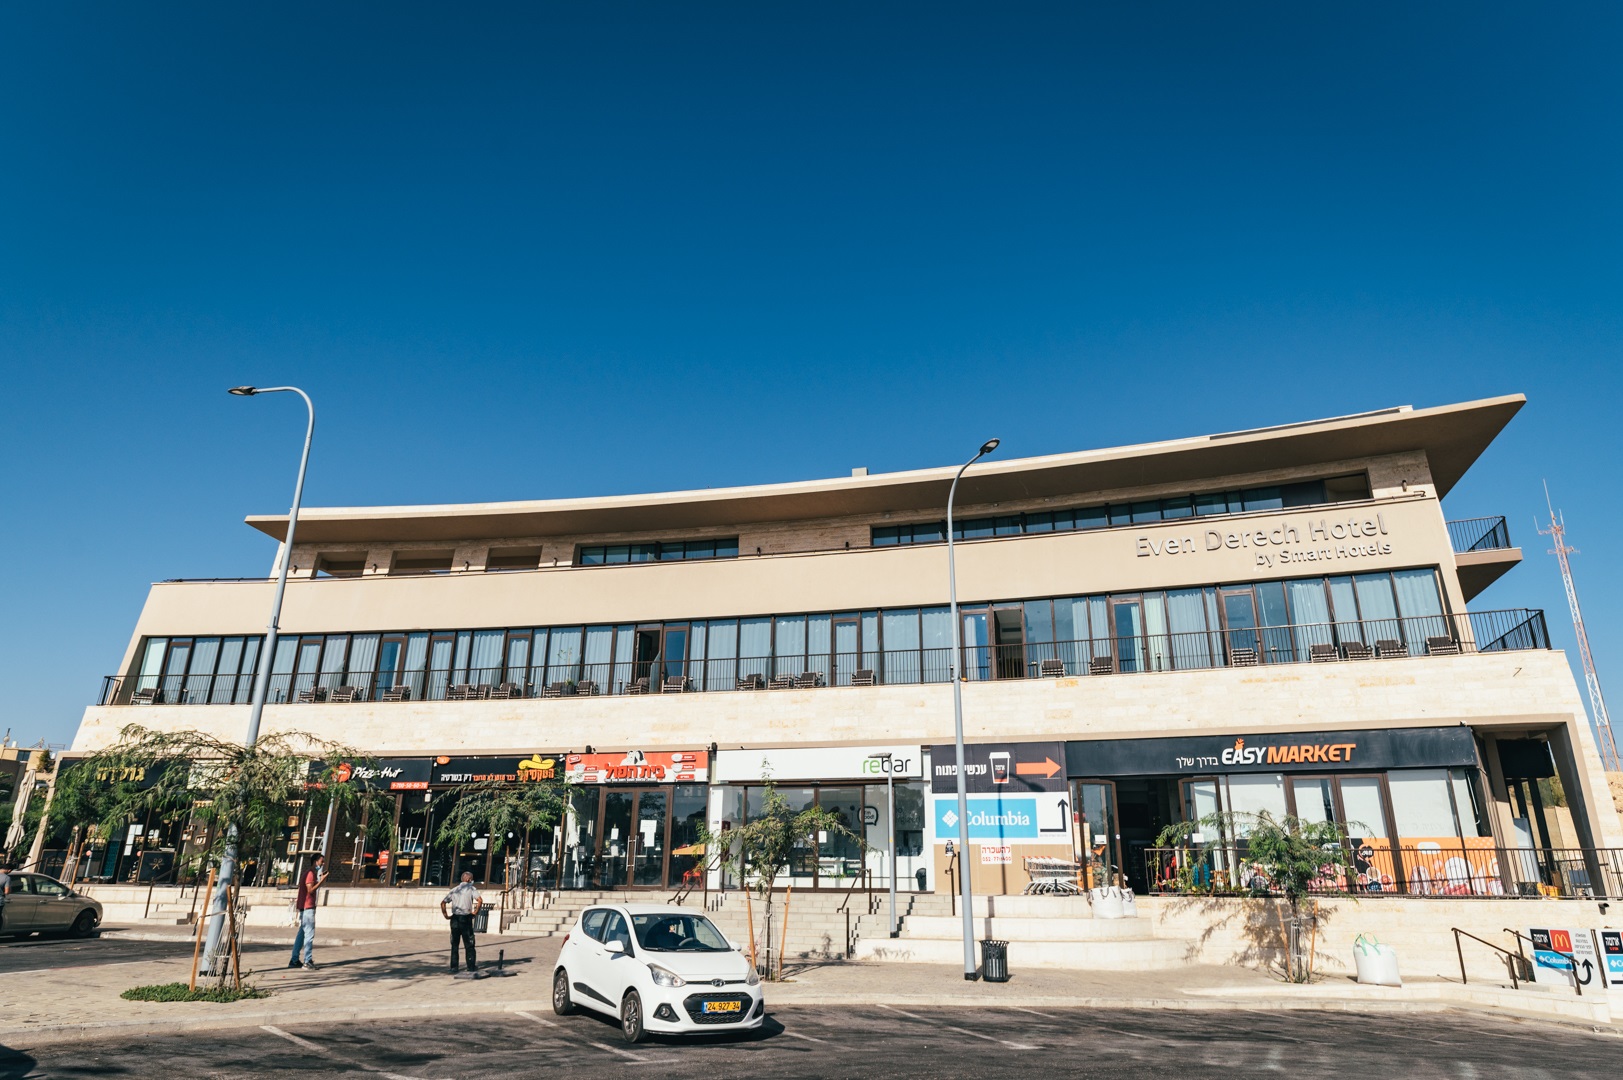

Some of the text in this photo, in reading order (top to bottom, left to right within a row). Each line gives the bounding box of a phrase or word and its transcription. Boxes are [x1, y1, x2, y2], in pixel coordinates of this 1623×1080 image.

[1135, 512, 1389, 558] Even Derech Hotel
[1255, 540, 1393, 568] by Smart Hotels
[1175, 756, 1219, 769] בדרך שלך
[1221, 743, 1357, 765] EASY MARKET
[380, 766, 404, 779] Hut
[604, 763, 666, 780] בית הפול
[862, 756, 912, 774] rebar
[962, 764, 987, 776] עכשי
[966, 810, 1031, 827] Columbia
[981, 846, 1011, 854] להשכרה
